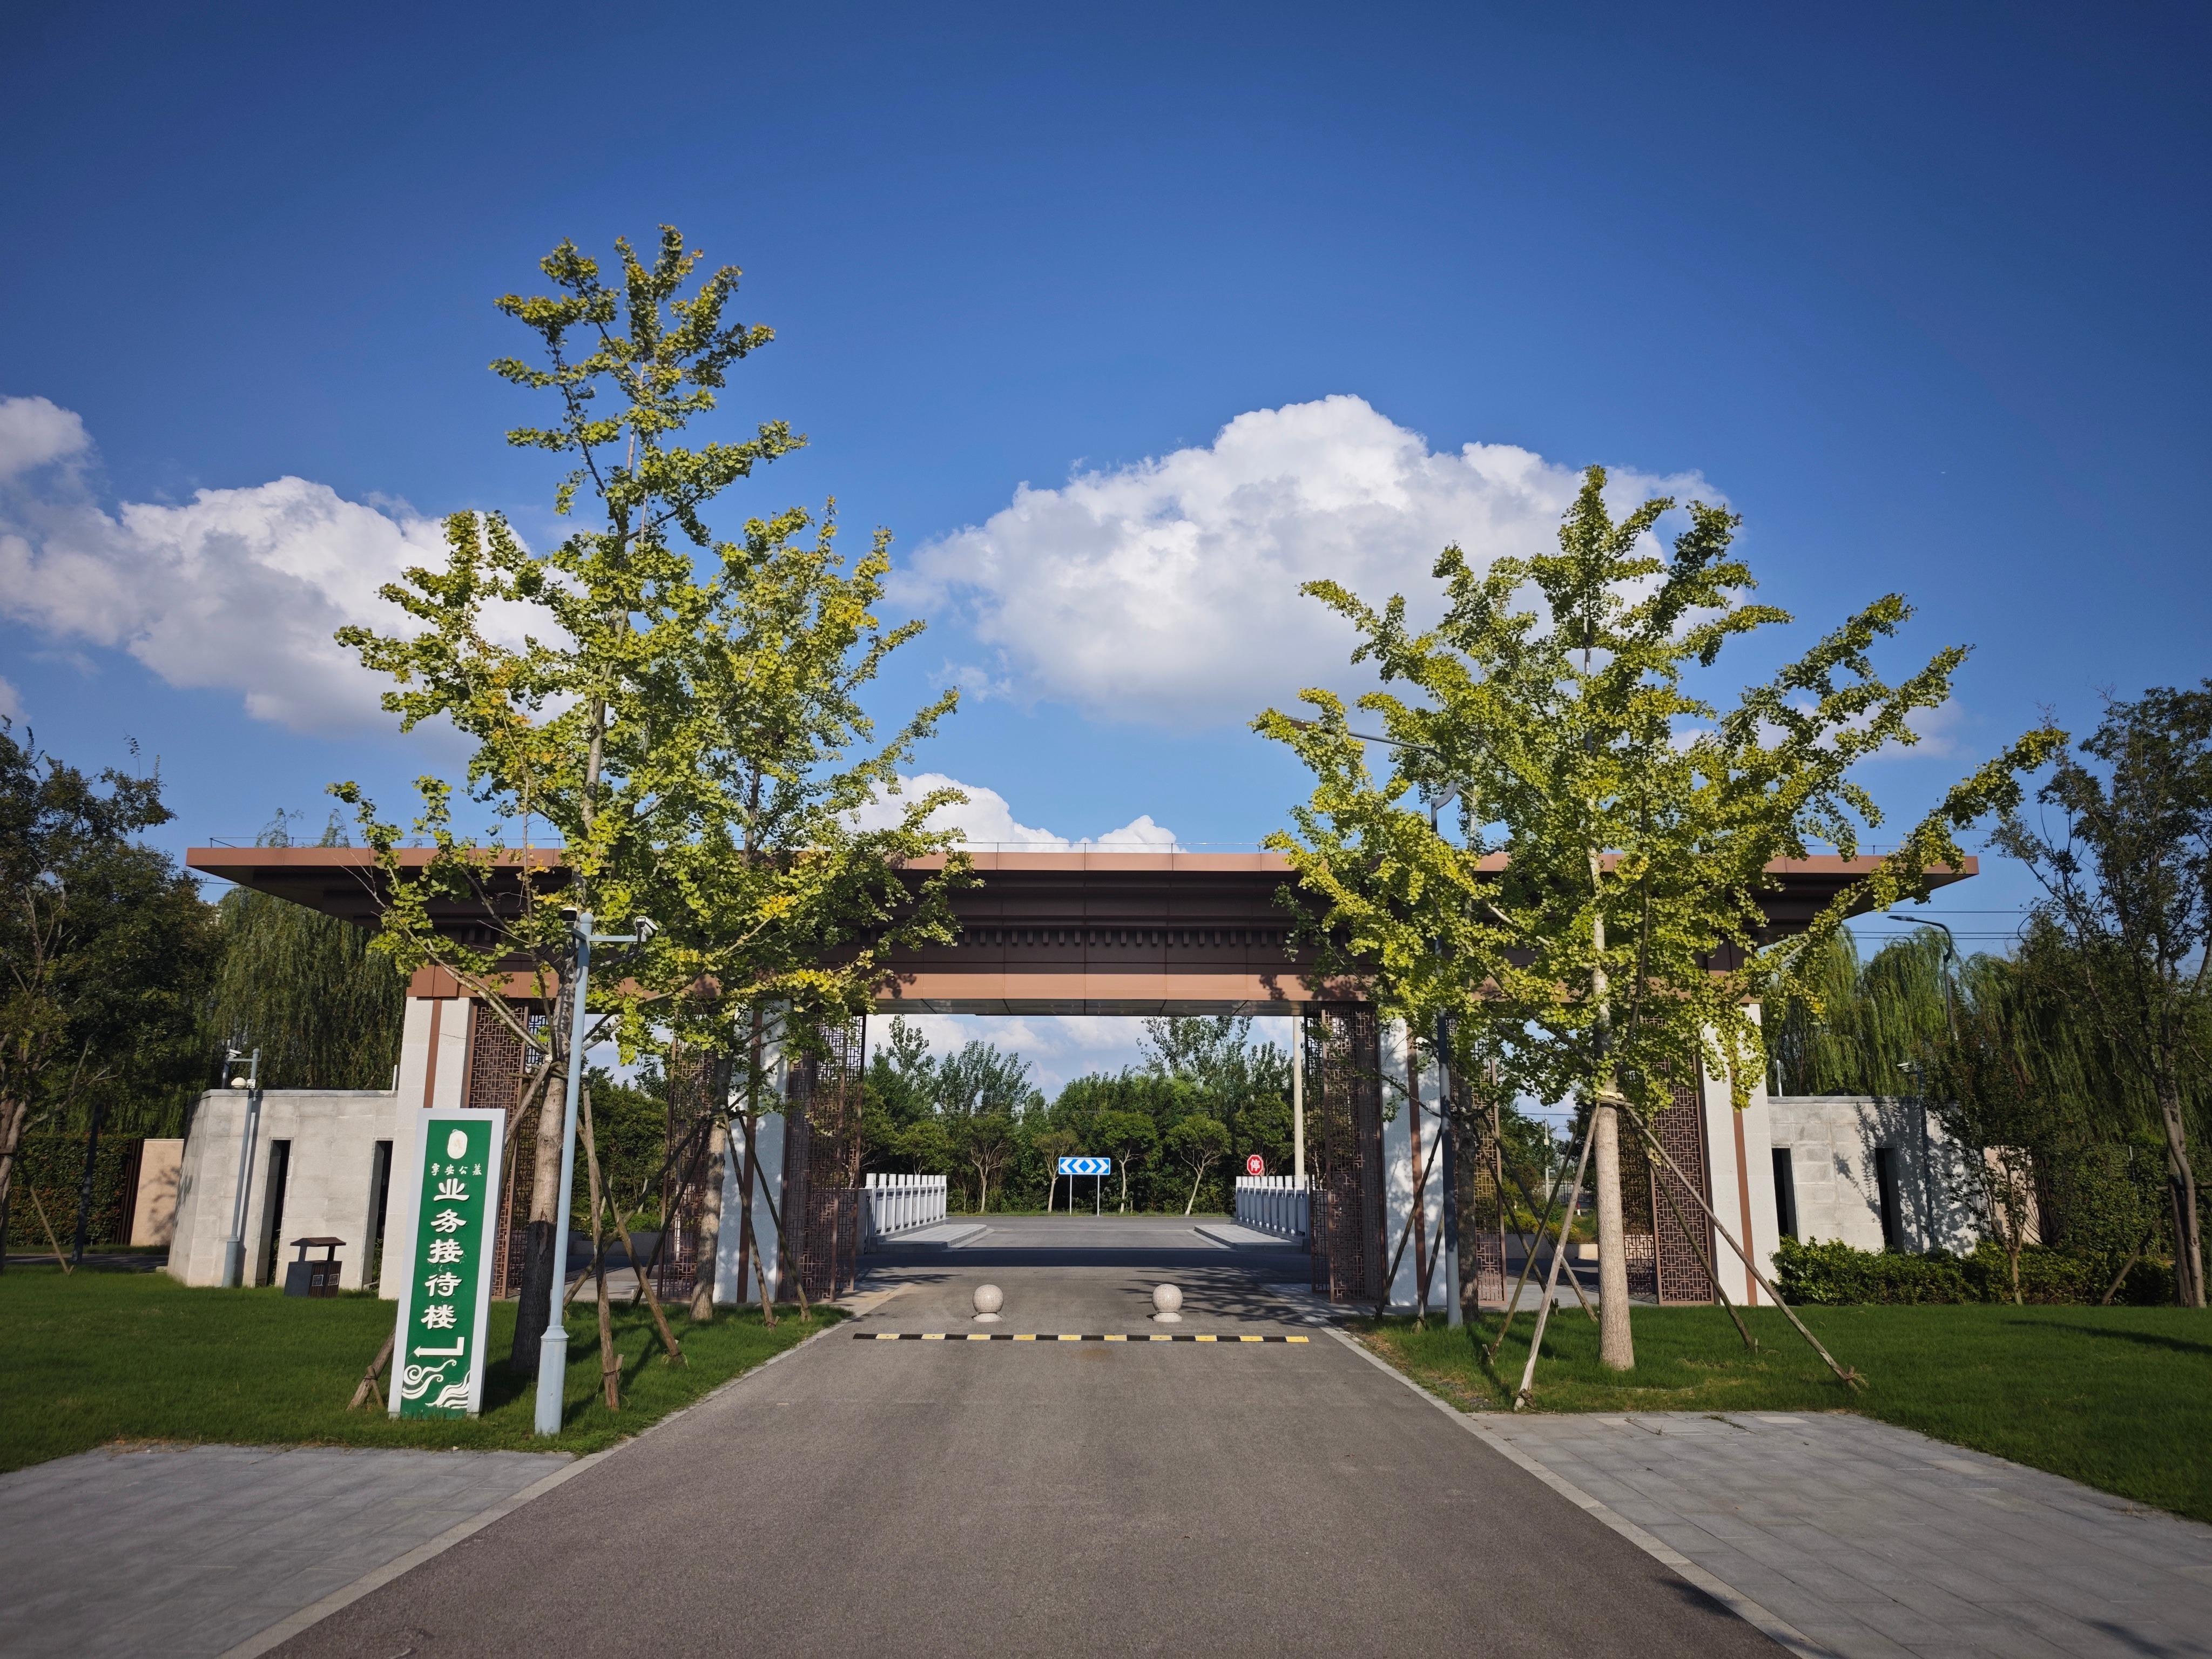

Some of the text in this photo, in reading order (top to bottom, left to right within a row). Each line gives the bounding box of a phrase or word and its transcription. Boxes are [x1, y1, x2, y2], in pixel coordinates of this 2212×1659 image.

[1250, 1159, 1260, 1171] 停
[421, 1178, 470, 1330] 业务接待楼
